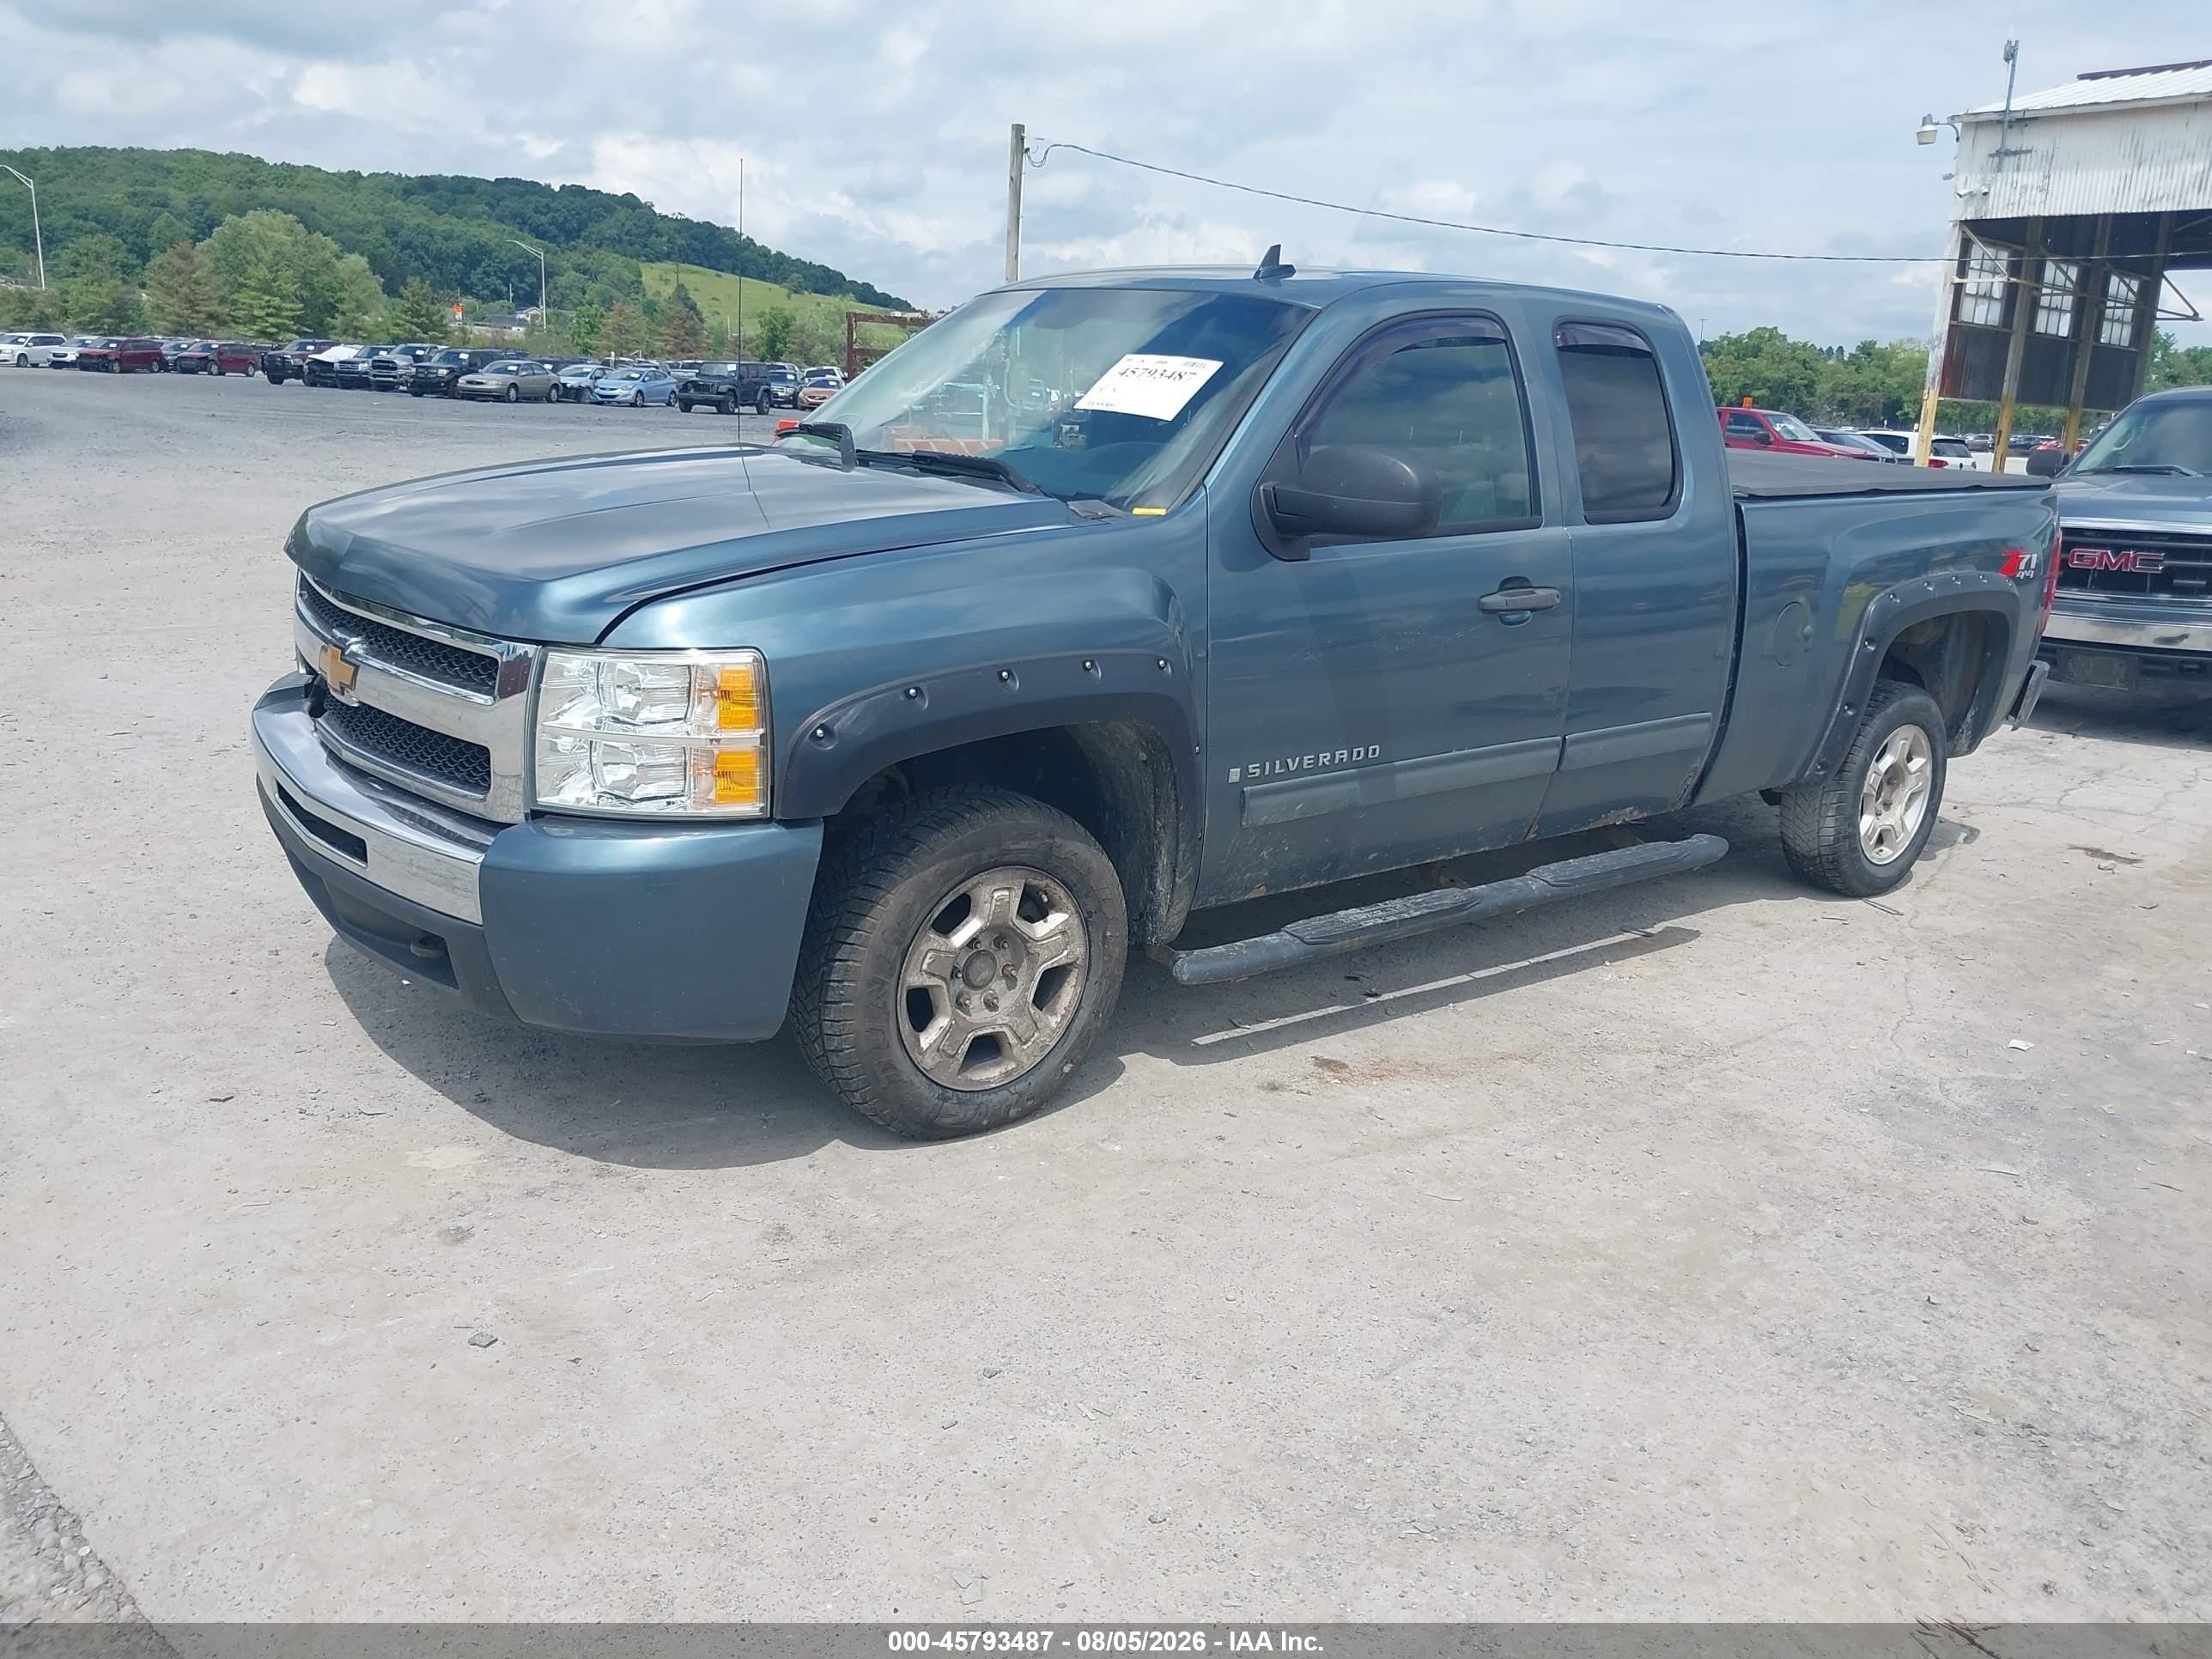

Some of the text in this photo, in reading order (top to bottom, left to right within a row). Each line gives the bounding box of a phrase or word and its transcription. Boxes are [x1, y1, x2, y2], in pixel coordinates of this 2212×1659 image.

[1118, 367, 1198, 383] 45793487
[1999, 550, 2038, 576] Z71
[2068, 548, 2166, 574] GMC
[1247, 744, 1380, 778] SILVERADO
